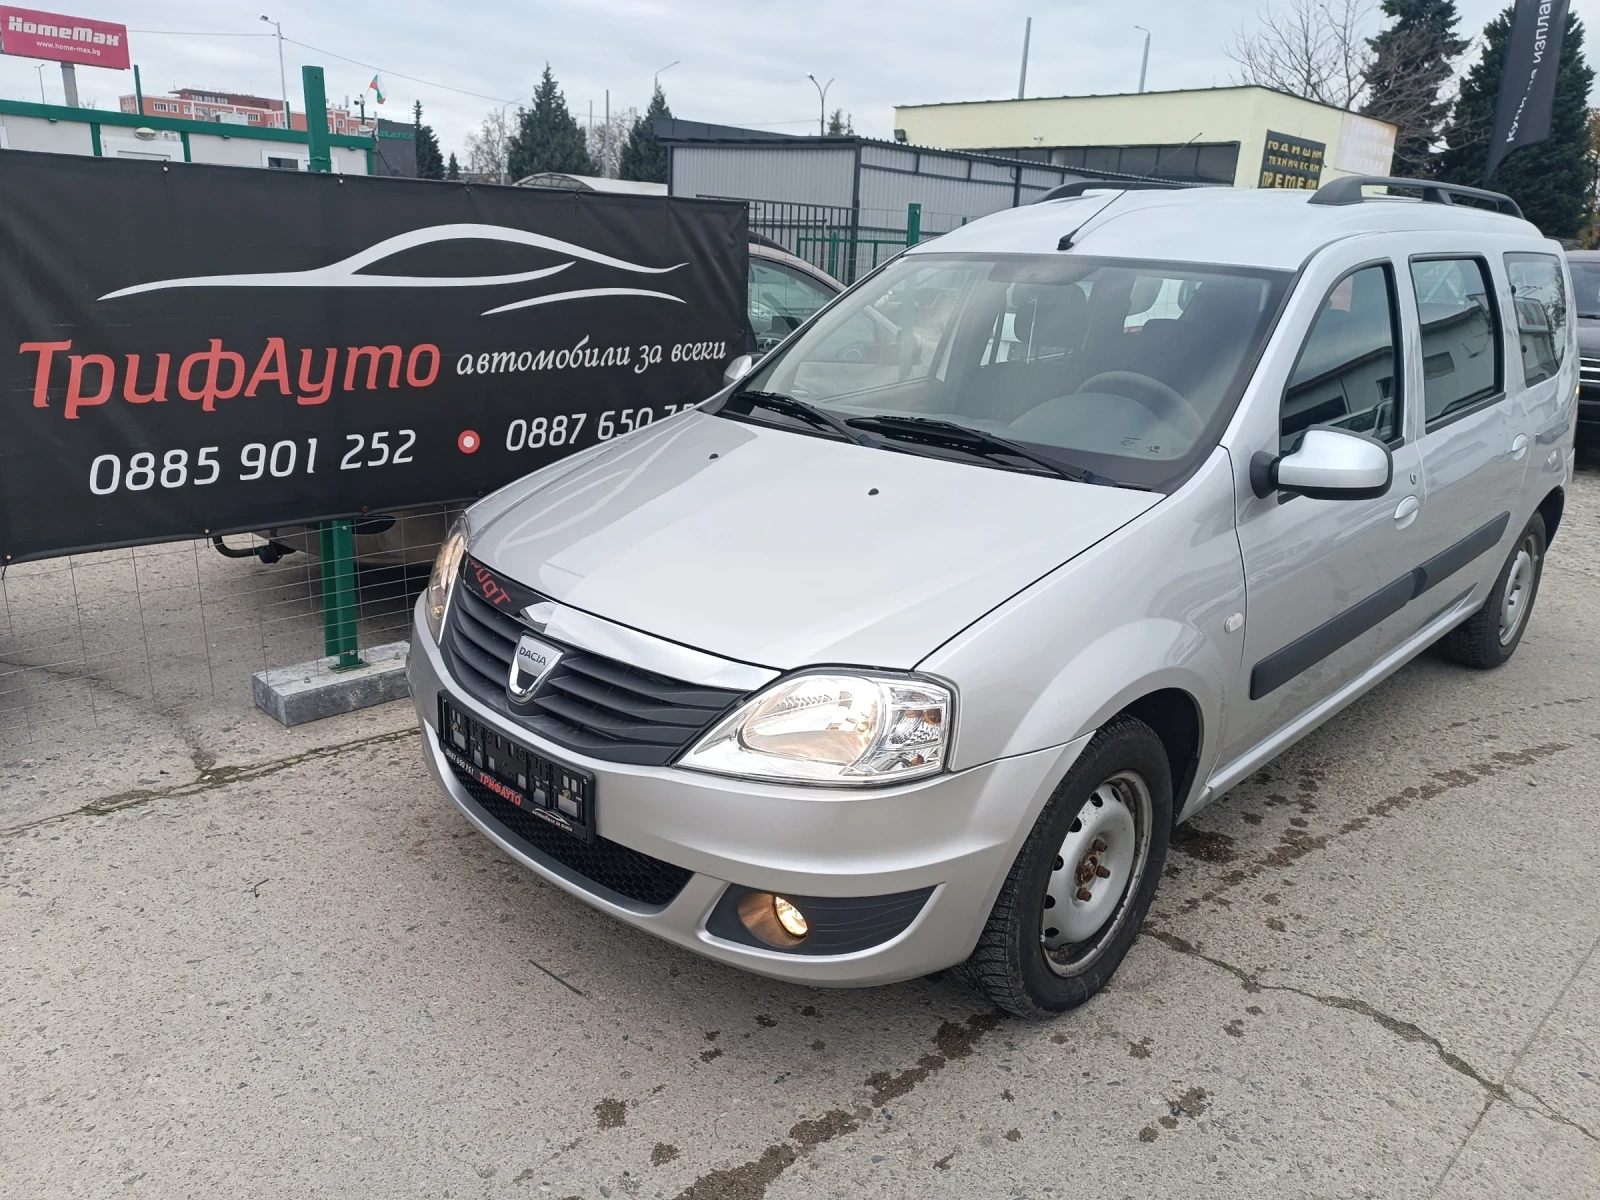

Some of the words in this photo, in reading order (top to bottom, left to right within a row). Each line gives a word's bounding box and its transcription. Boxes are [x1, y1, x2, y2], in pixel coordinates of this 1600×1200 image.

[8, 15, 119, 46] HomeMax
[36, 41, 101, 56] www.home-max.bg
[1268, 155, 1320, 173] ТЕХНИЧЕСКИ
[456, 334, 630, 375] автомобили
[634, 344, 663, 374] за
[671, 340, 726, 363] всеки
[19, 337, 441, 419] ТрифАуто
[505, 413, 587, 451] 0887
[597, 407, 653, 441] 650
[89, 446, 220, 495] 0885
[239, 438, 318, 481] 901
[340, 429, 417, 470] 252
[518, 646, 547, 666] DACIA
[480, 773, 522, 806] ТРИФАУТО
